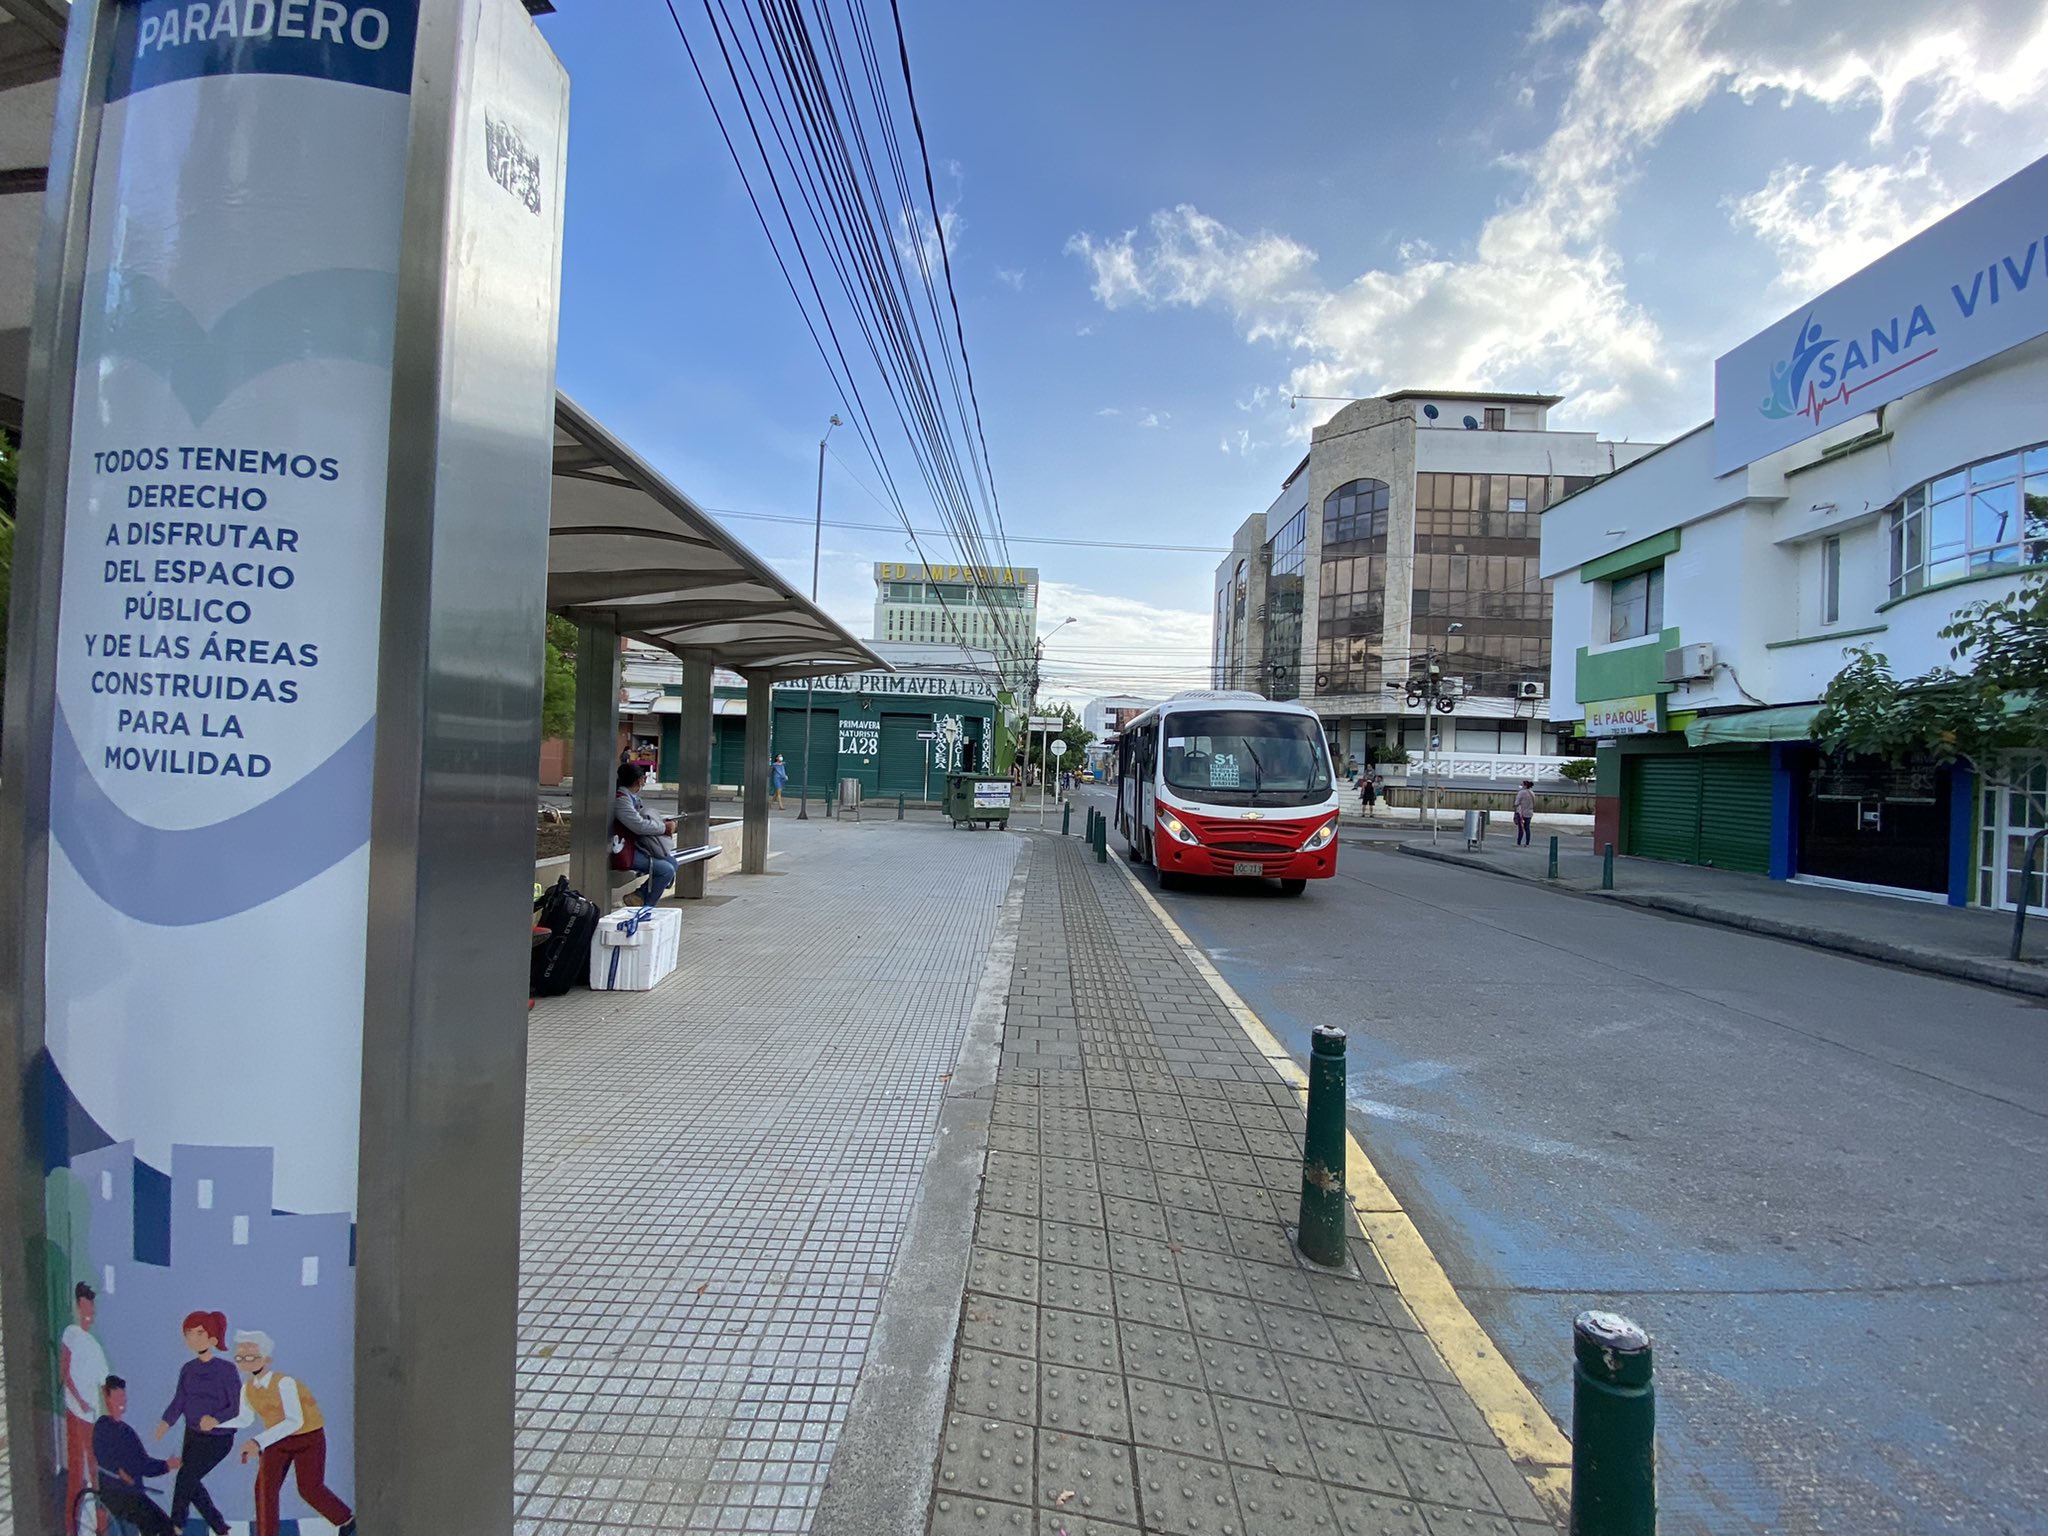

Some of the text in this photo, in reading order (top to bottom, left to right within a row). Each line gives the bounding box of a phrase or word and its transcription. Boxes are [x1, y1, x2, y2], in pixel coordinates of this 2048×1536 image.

[138, 0, 389, 58] PARADERO
[1819, 304, 1936, 389] SANA
[94, 447, 339, 481] TODOS TENEMOS
[128, 485, 267, 511] DERECHO
[105, 522, 299, 552] A DISFRUTAR
[104, 559, 295, 590] DEL ESPACIO
[125, 591, 251, 624] PÚBLICO
[85, 630, 319, 667] Y DE LAS ÁREAS
[91, 671, 298, 704] CONSTRUIDAS
[859, 675, 957, 695] PRIMAVERA
[118, 709, 244, 739] PARA LA
[839, 720, 880, 730] PRIMAVERA
[1593, 709, 1648, 726] EL PARQUE
[838, 737, 878, 755] LA28
[839, 730, 879, 738] NATURISTA
[104, 746, 272, 778] MOVILIDAD
